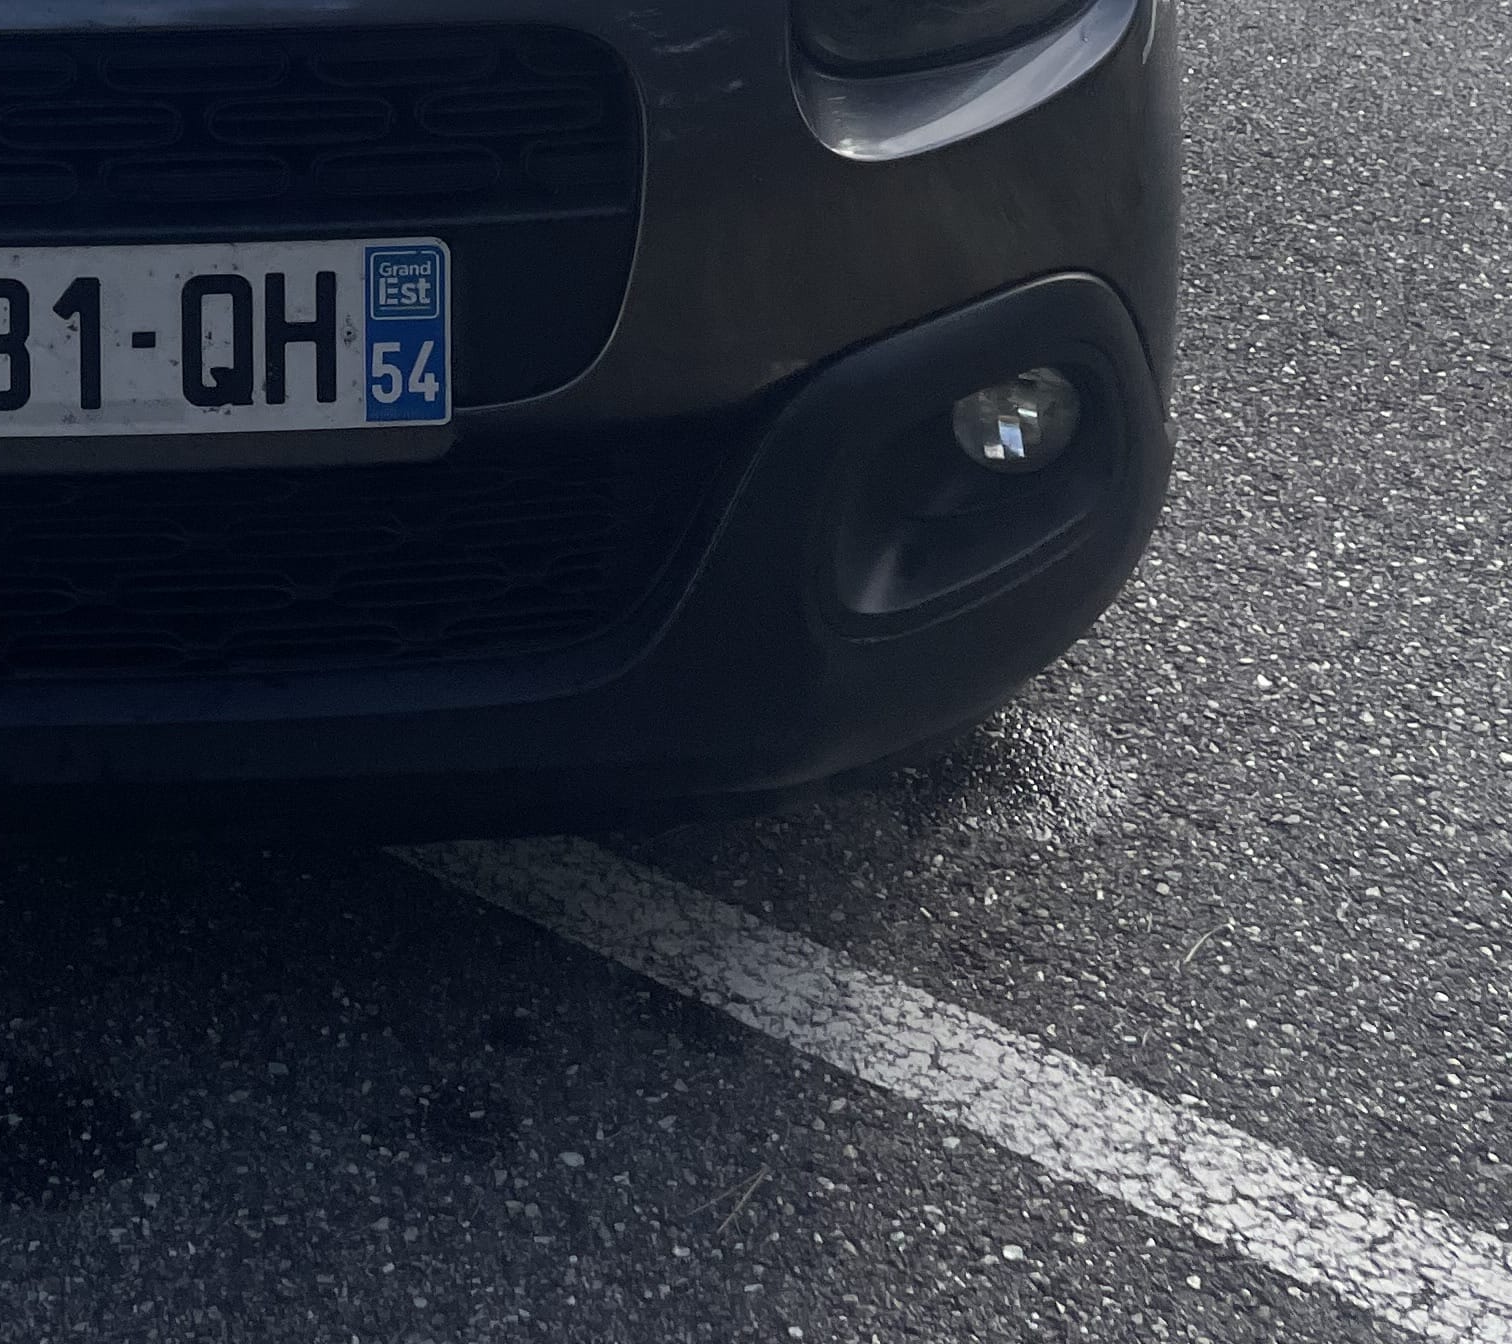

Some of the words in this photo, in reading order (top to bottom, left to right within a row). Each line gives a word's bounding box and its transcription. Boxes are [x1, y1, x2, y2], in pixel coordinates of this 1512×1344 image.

[378, 261, 432, 277] Grand
[378, 277, 432, 306] Est
[371, 340, 440, 404] 54
